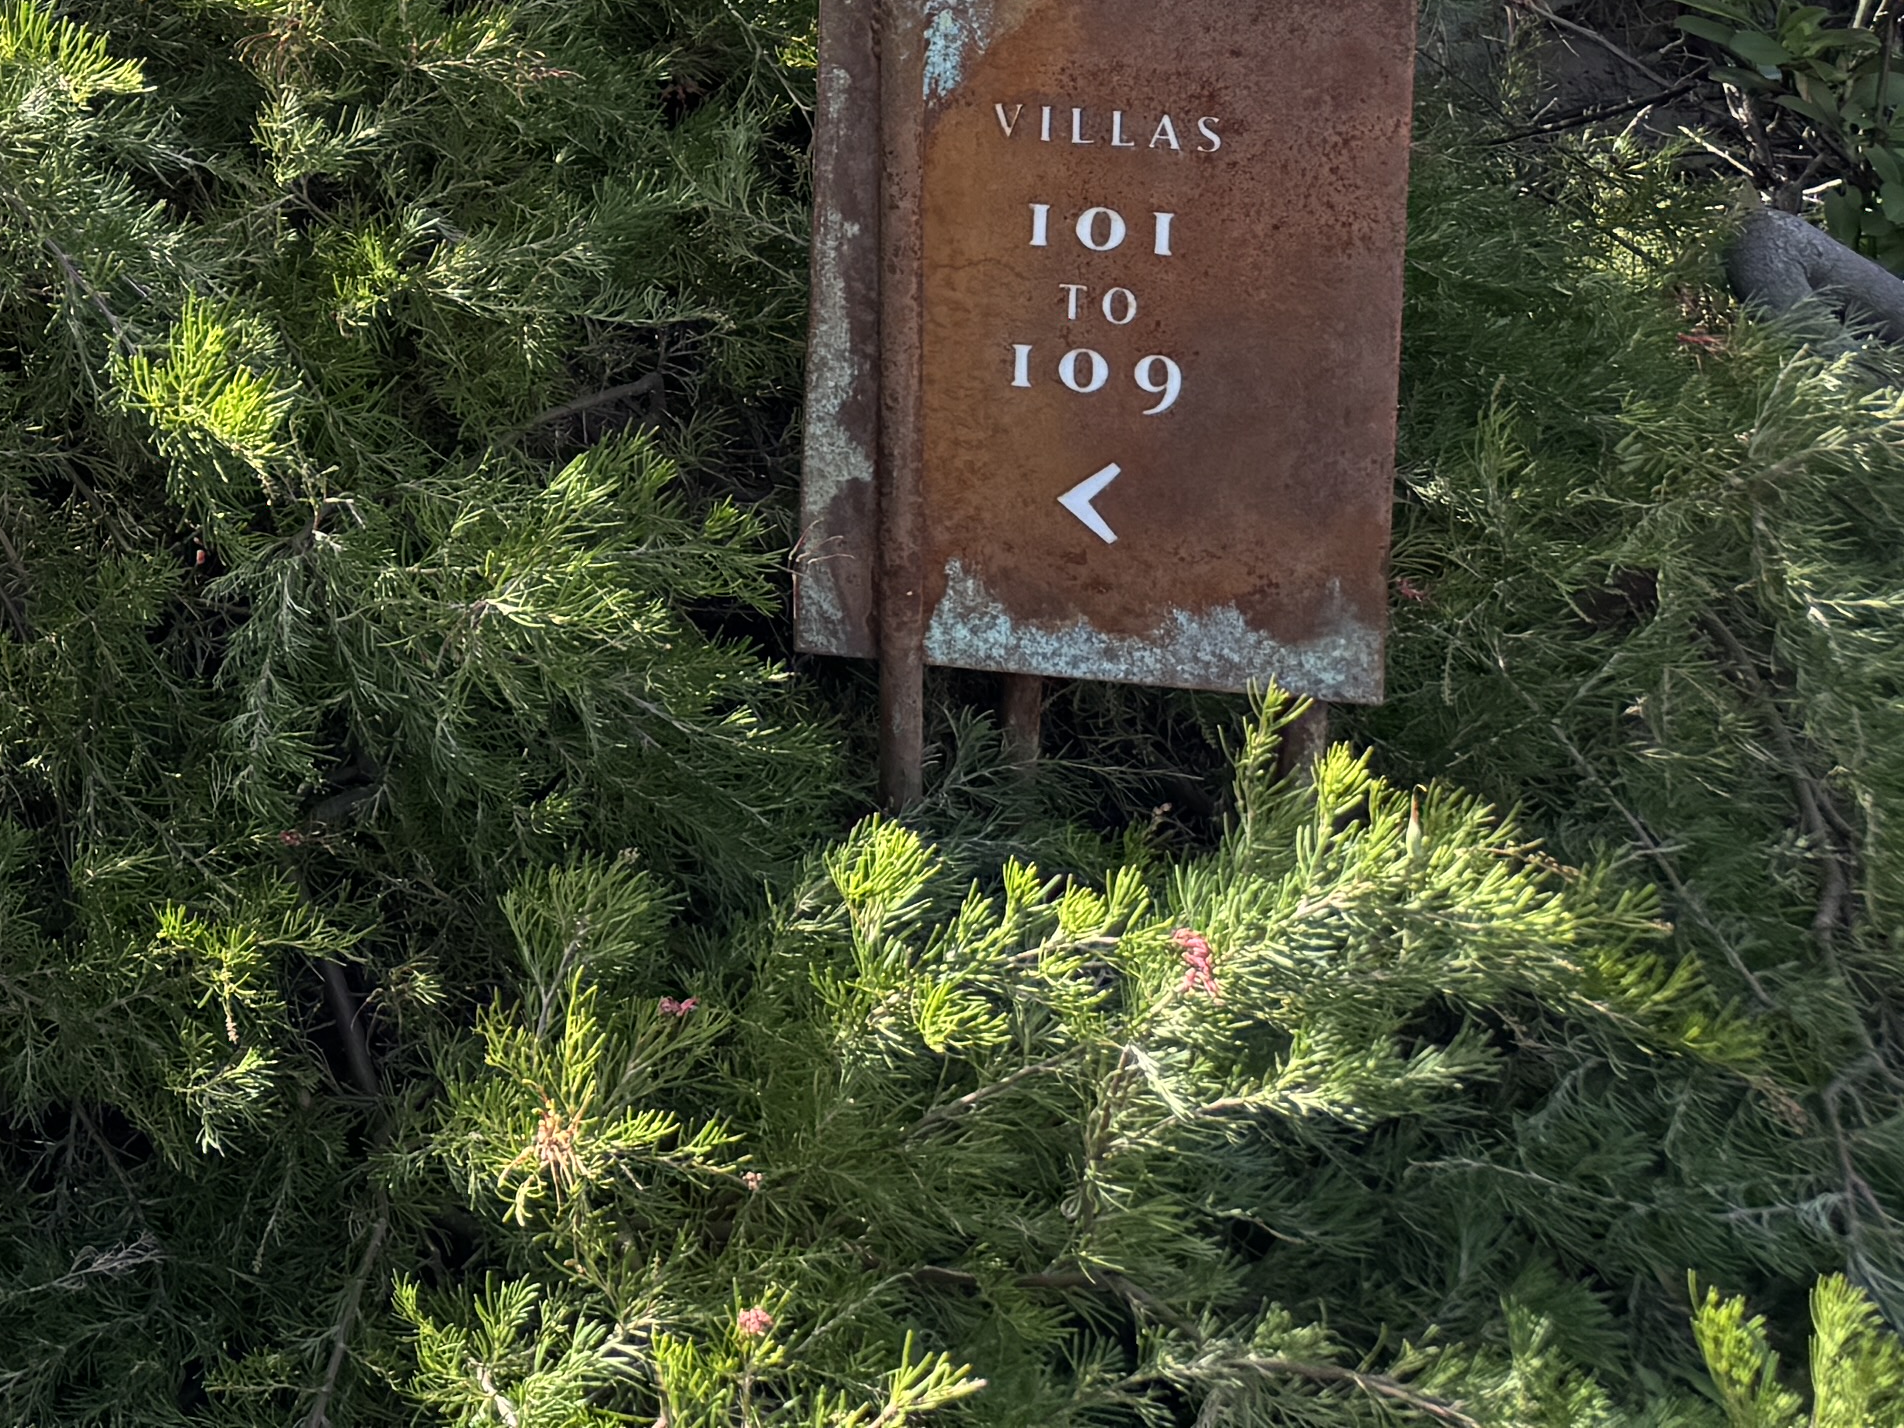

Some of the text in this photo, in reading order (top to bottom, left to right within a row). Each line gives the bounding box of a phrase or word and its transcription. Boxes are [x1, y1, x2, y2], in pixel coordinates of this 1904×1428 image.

[994, 103, 1222, 153] VILLAS
[1029, 203, 1175, 256] 101
[1058, 283, 1138, 325] TO
[1010, 344, 1182, 415] 109
